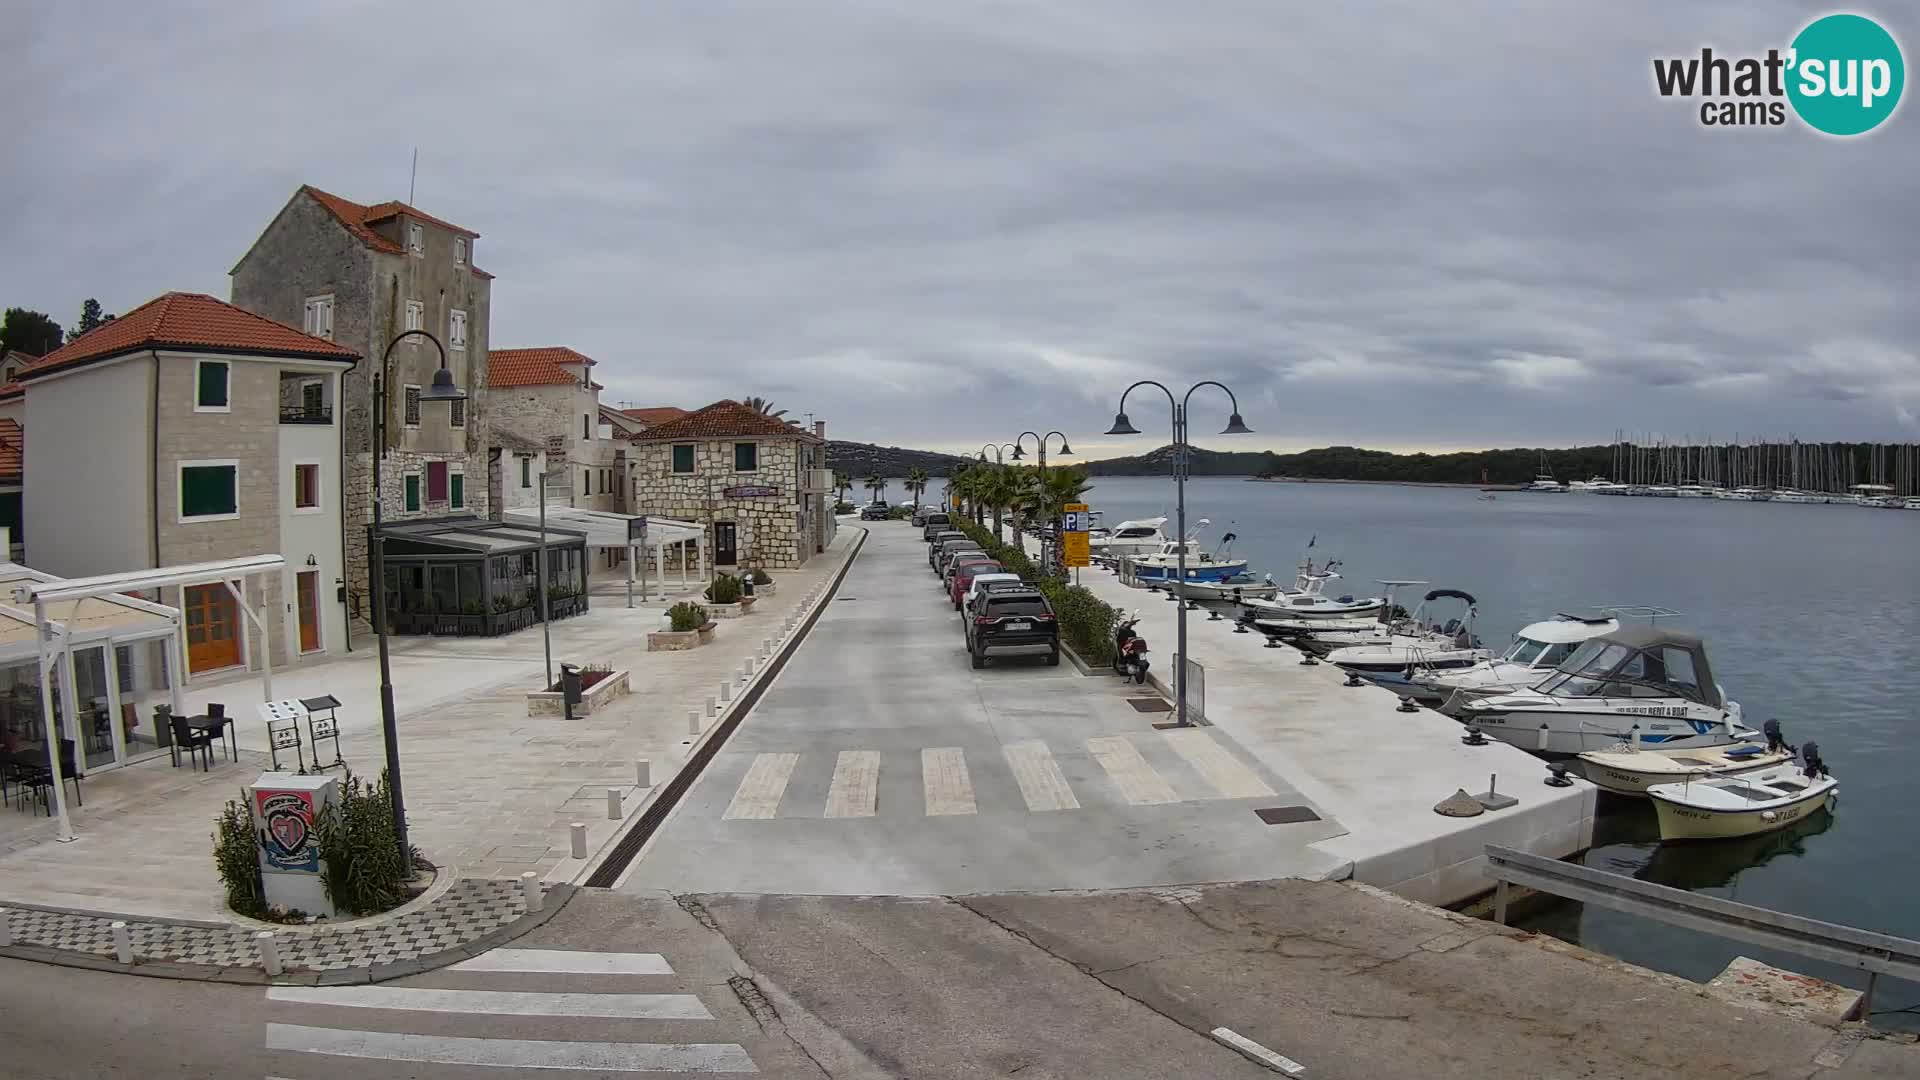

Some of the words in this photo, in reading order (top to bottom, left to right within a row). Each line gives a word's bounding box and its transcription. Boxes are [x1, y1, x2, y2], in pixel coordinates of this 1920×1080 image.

[1066, 513, 1076, 530] P
[1648, 706, 1665, 717] RENT
[1666, 707, 1671, 716] A
[1672, 706, 1688, 718] BOAT
